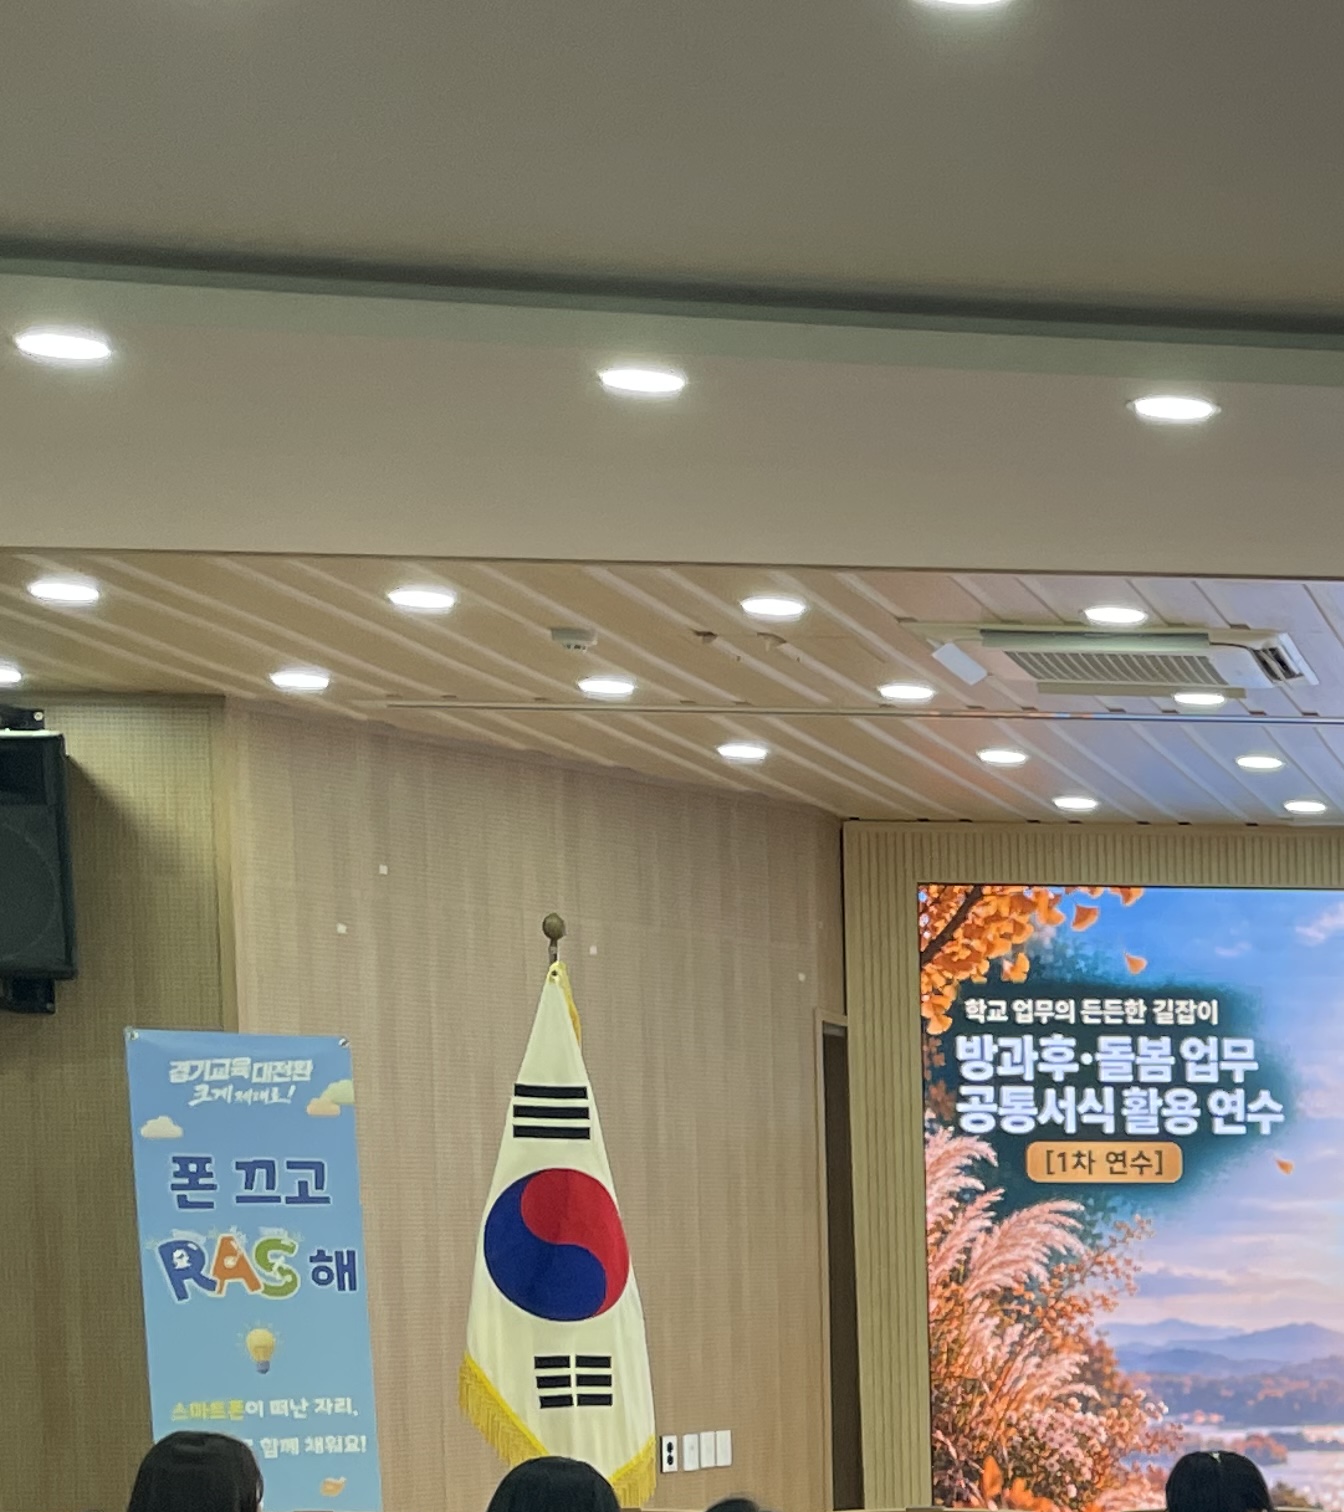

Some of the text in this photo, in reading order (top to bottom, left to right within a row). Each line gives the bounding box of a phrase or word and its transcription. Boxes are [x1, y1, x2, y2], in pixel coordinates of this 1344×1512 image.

[964, 999, 1219, 1025] 학교 업무의 든든한 길잡이
[955, 1035, 1259, 1084] 방과후·돌봄 업무
[955, 1085, 1286, 1135] 공통서식 활용 연수
[170, 1155, 331, 1210] 폰 끄고
[1105, 1150, 1164, 1176] 연수]
[308, 1248, 358, 1293] 해
